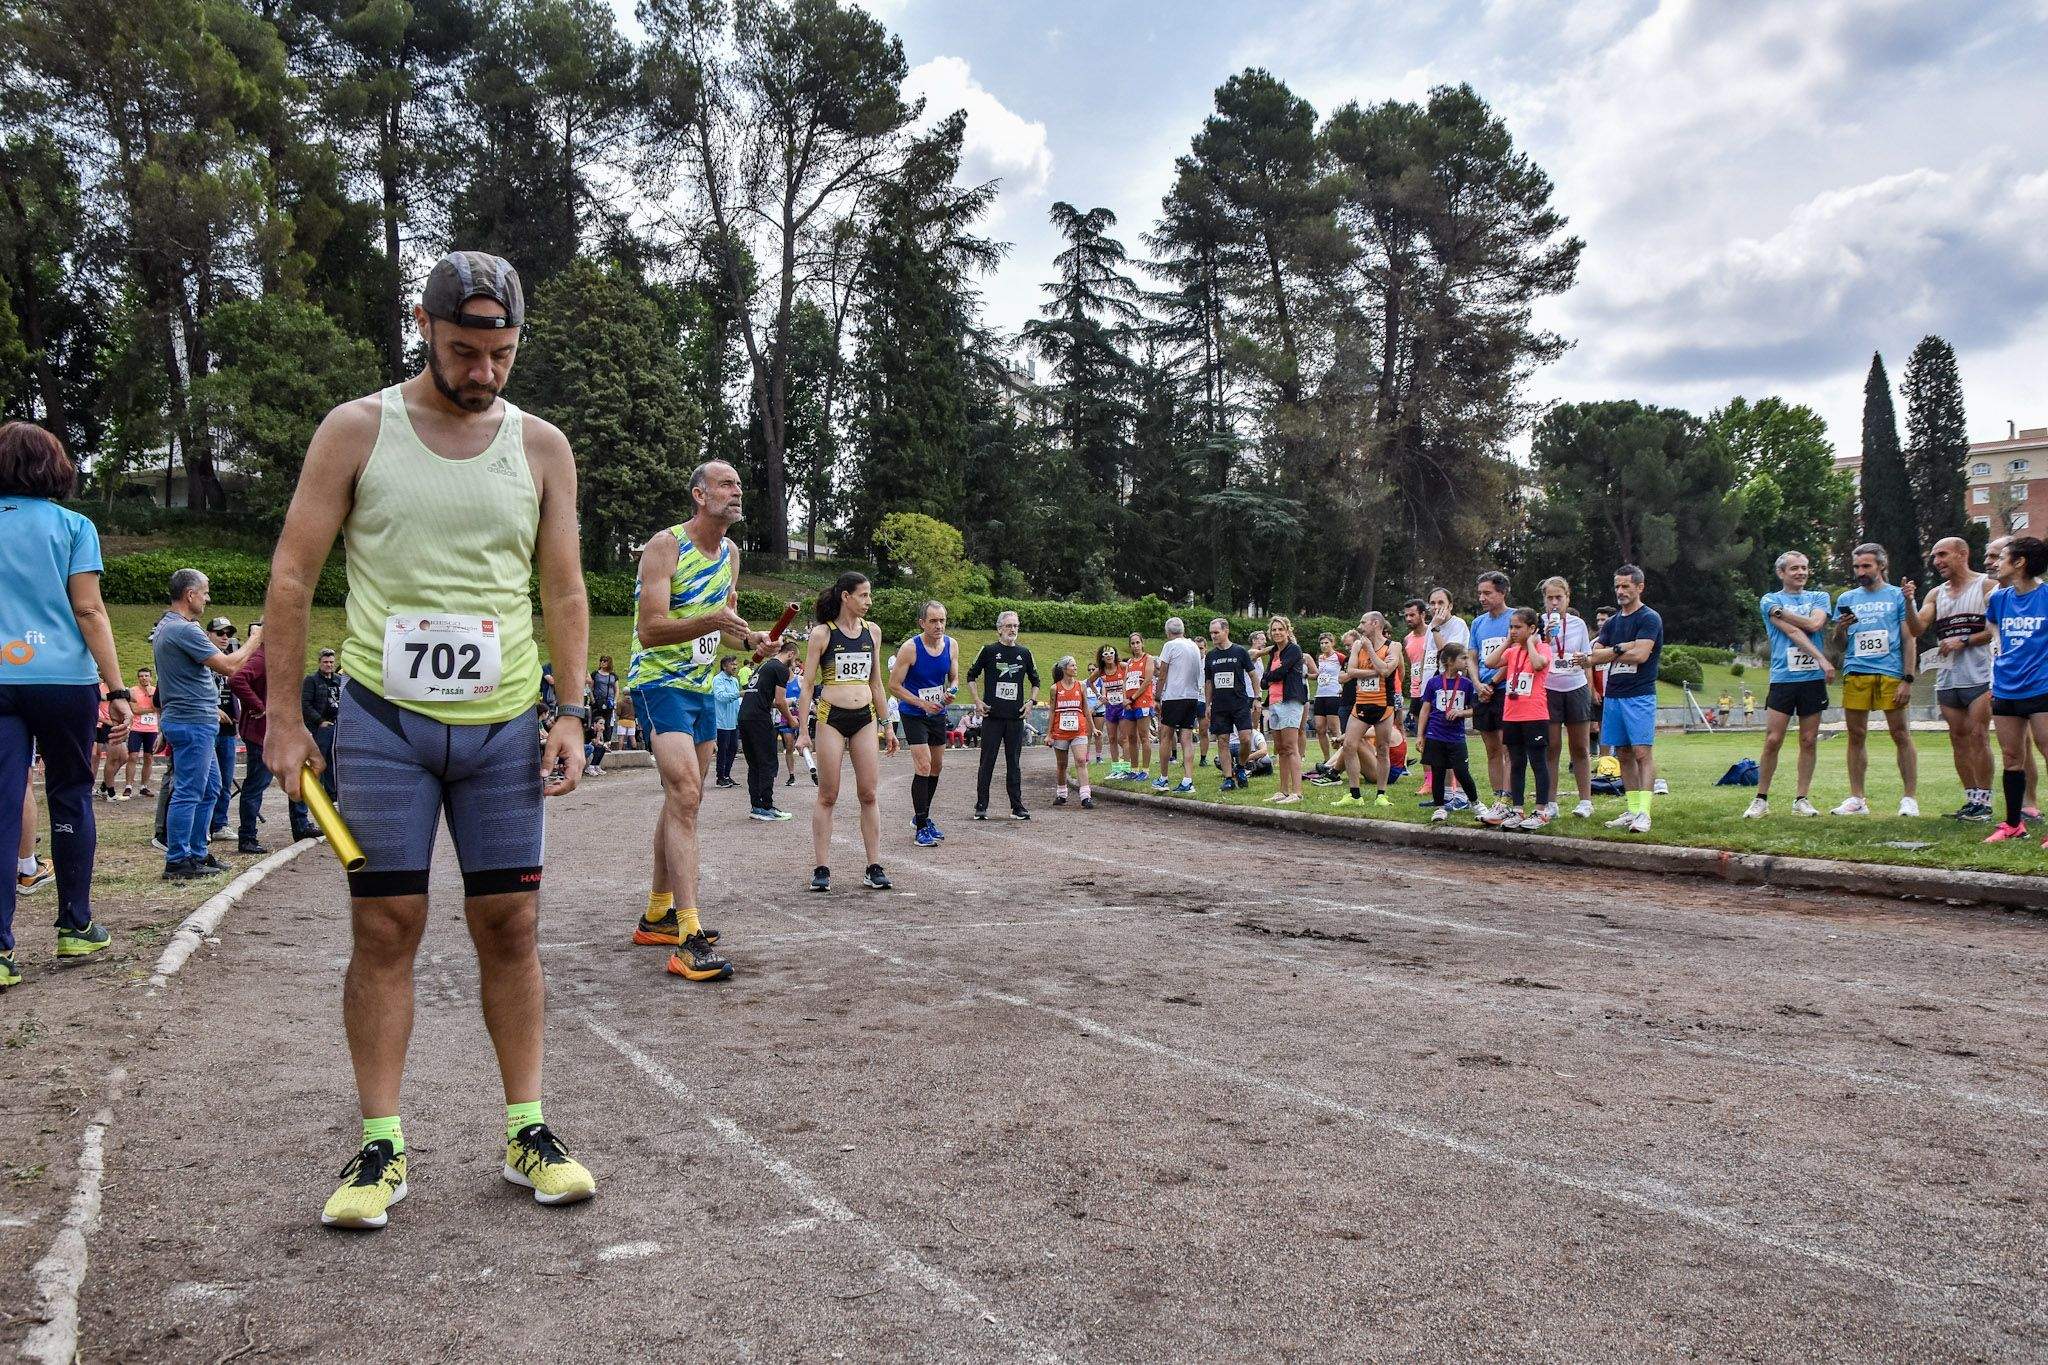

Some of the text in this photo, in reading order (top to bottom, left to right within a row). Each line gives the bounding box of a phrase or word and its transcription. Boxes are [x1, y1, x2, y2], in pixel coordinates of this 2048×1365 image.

[487, 466, 518, 478] adidas
[25, 630, 47, 645] fit
[1860, 638, 1882, 650] 883
[404, 642, 481, 680] 702
[842, 662, 866, 675] 887
[441, 685, 494, 695] rasán 2023
[1000, 688, 1015, 696] 709
[1441, 696, 1459, 706] 91
